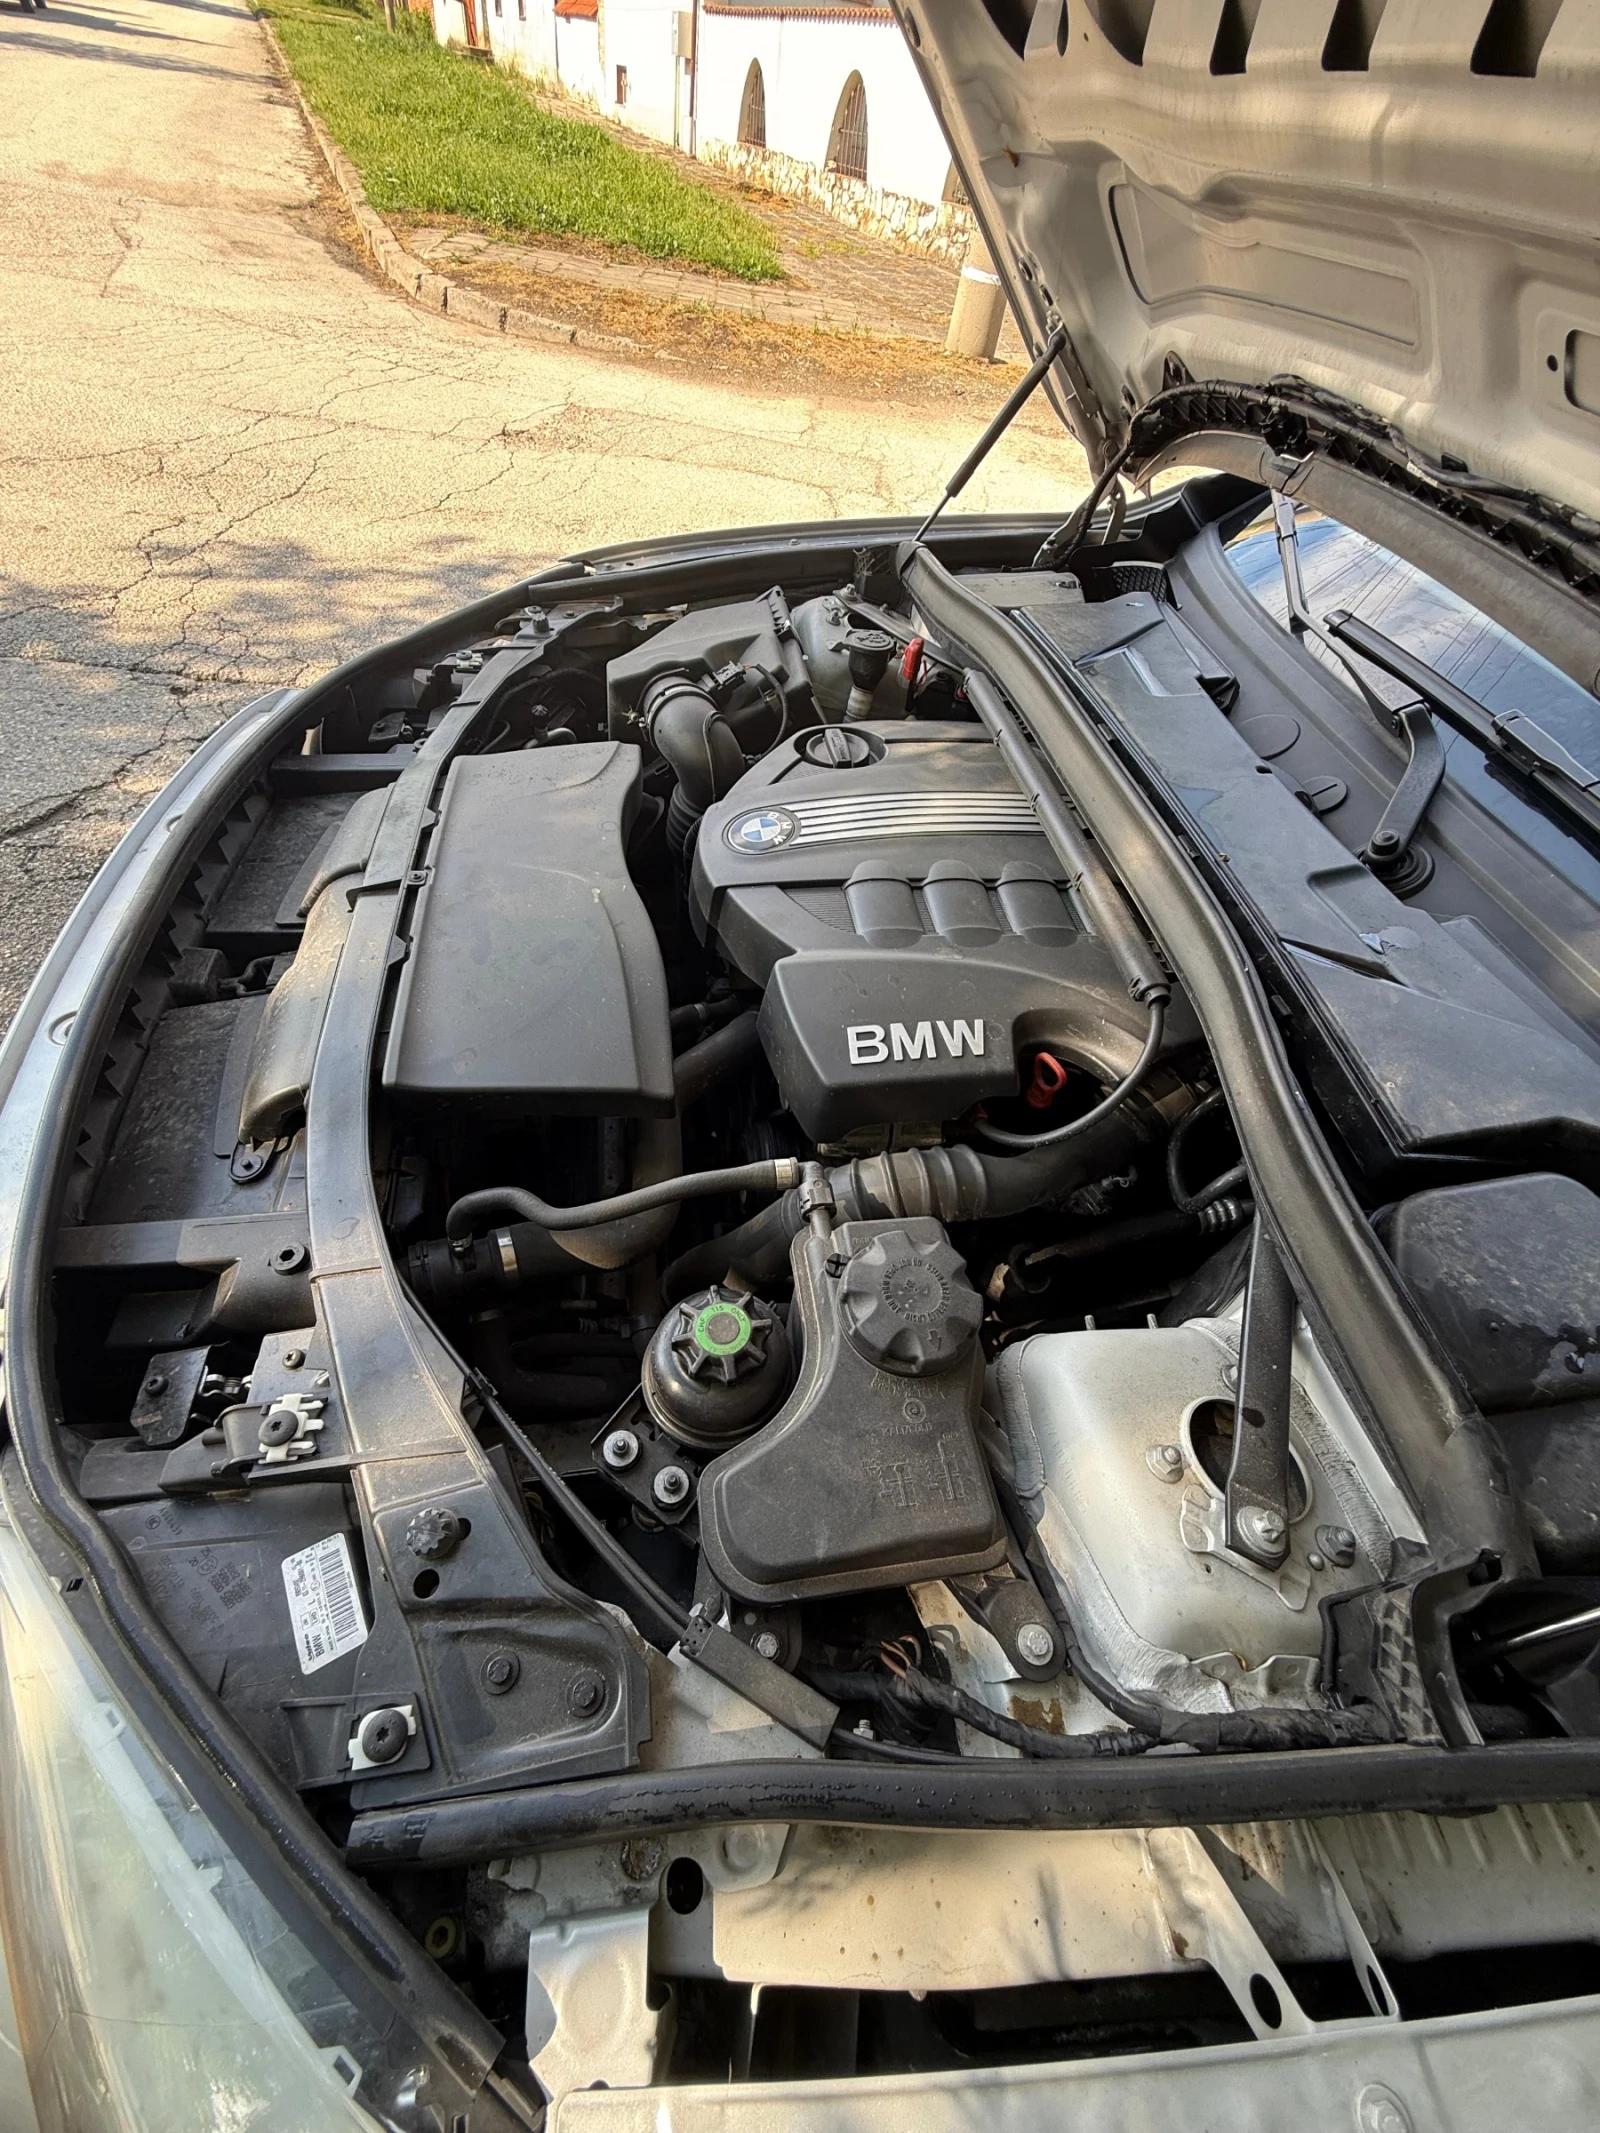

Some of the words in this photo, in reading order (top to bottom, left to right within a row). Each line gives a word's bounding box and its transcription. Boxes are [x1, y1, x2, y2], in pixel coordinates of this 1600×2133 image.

[767, 812, 792, 845] BMW
[847, 1019, 985, 1064] BMW
[731, 1307, 747, 1321] ONLY
[312, 1634, 325, 1657] BMW
